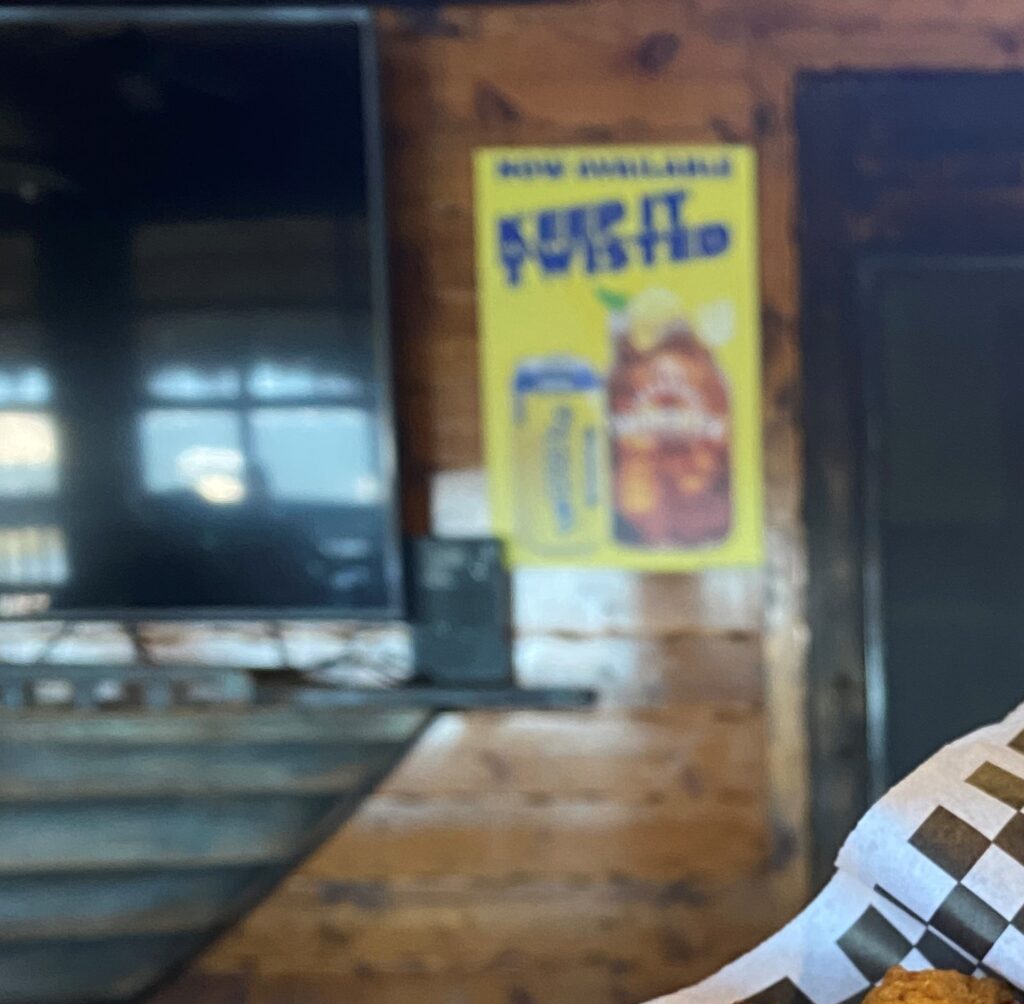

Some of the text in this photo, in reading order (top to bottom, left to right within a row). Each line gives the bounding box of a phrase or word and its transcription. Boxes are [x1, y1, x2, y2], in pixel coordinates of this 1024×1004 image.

[497, 159, 563, 179] NOW
[498, 188, 687, 248] KEEP IT
[500, 222, 731, 288] TWISTED
